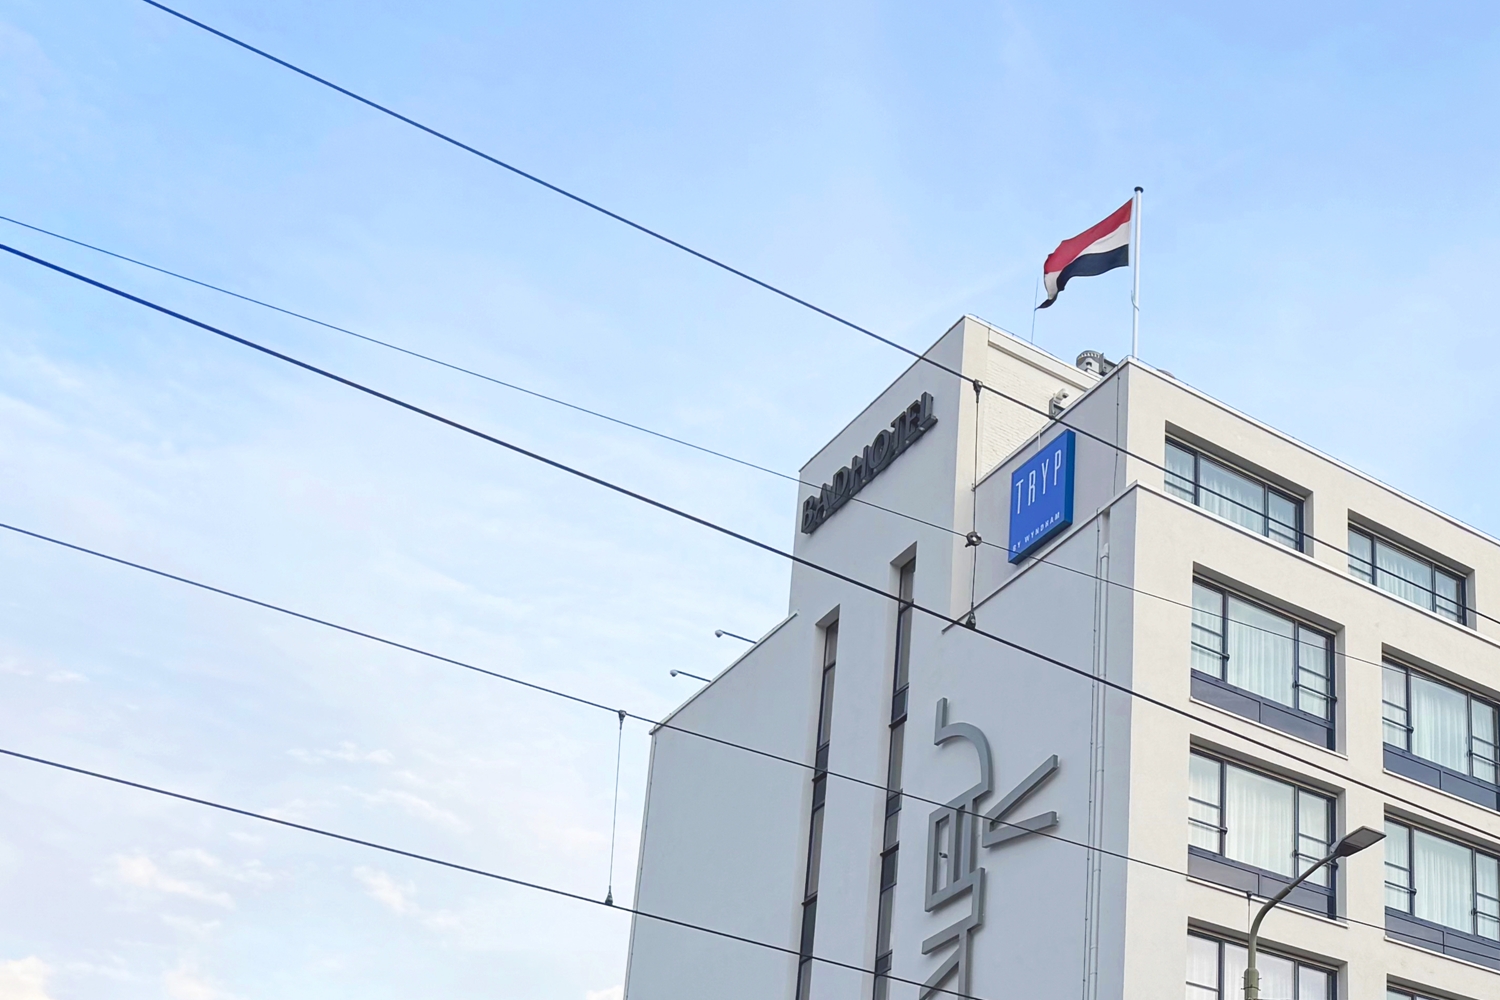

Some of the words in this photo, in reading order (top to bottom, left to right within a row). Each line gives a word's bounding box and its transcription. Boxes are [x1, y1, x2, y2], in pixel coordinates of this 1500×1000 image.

[801, 391, 938, 534] BADHOTEL
[1015, 449, 1062, 515] TRYP
[1012, 540, 1021, 552] BY
[1024, 511, 1060, 542] WYNDHAM
